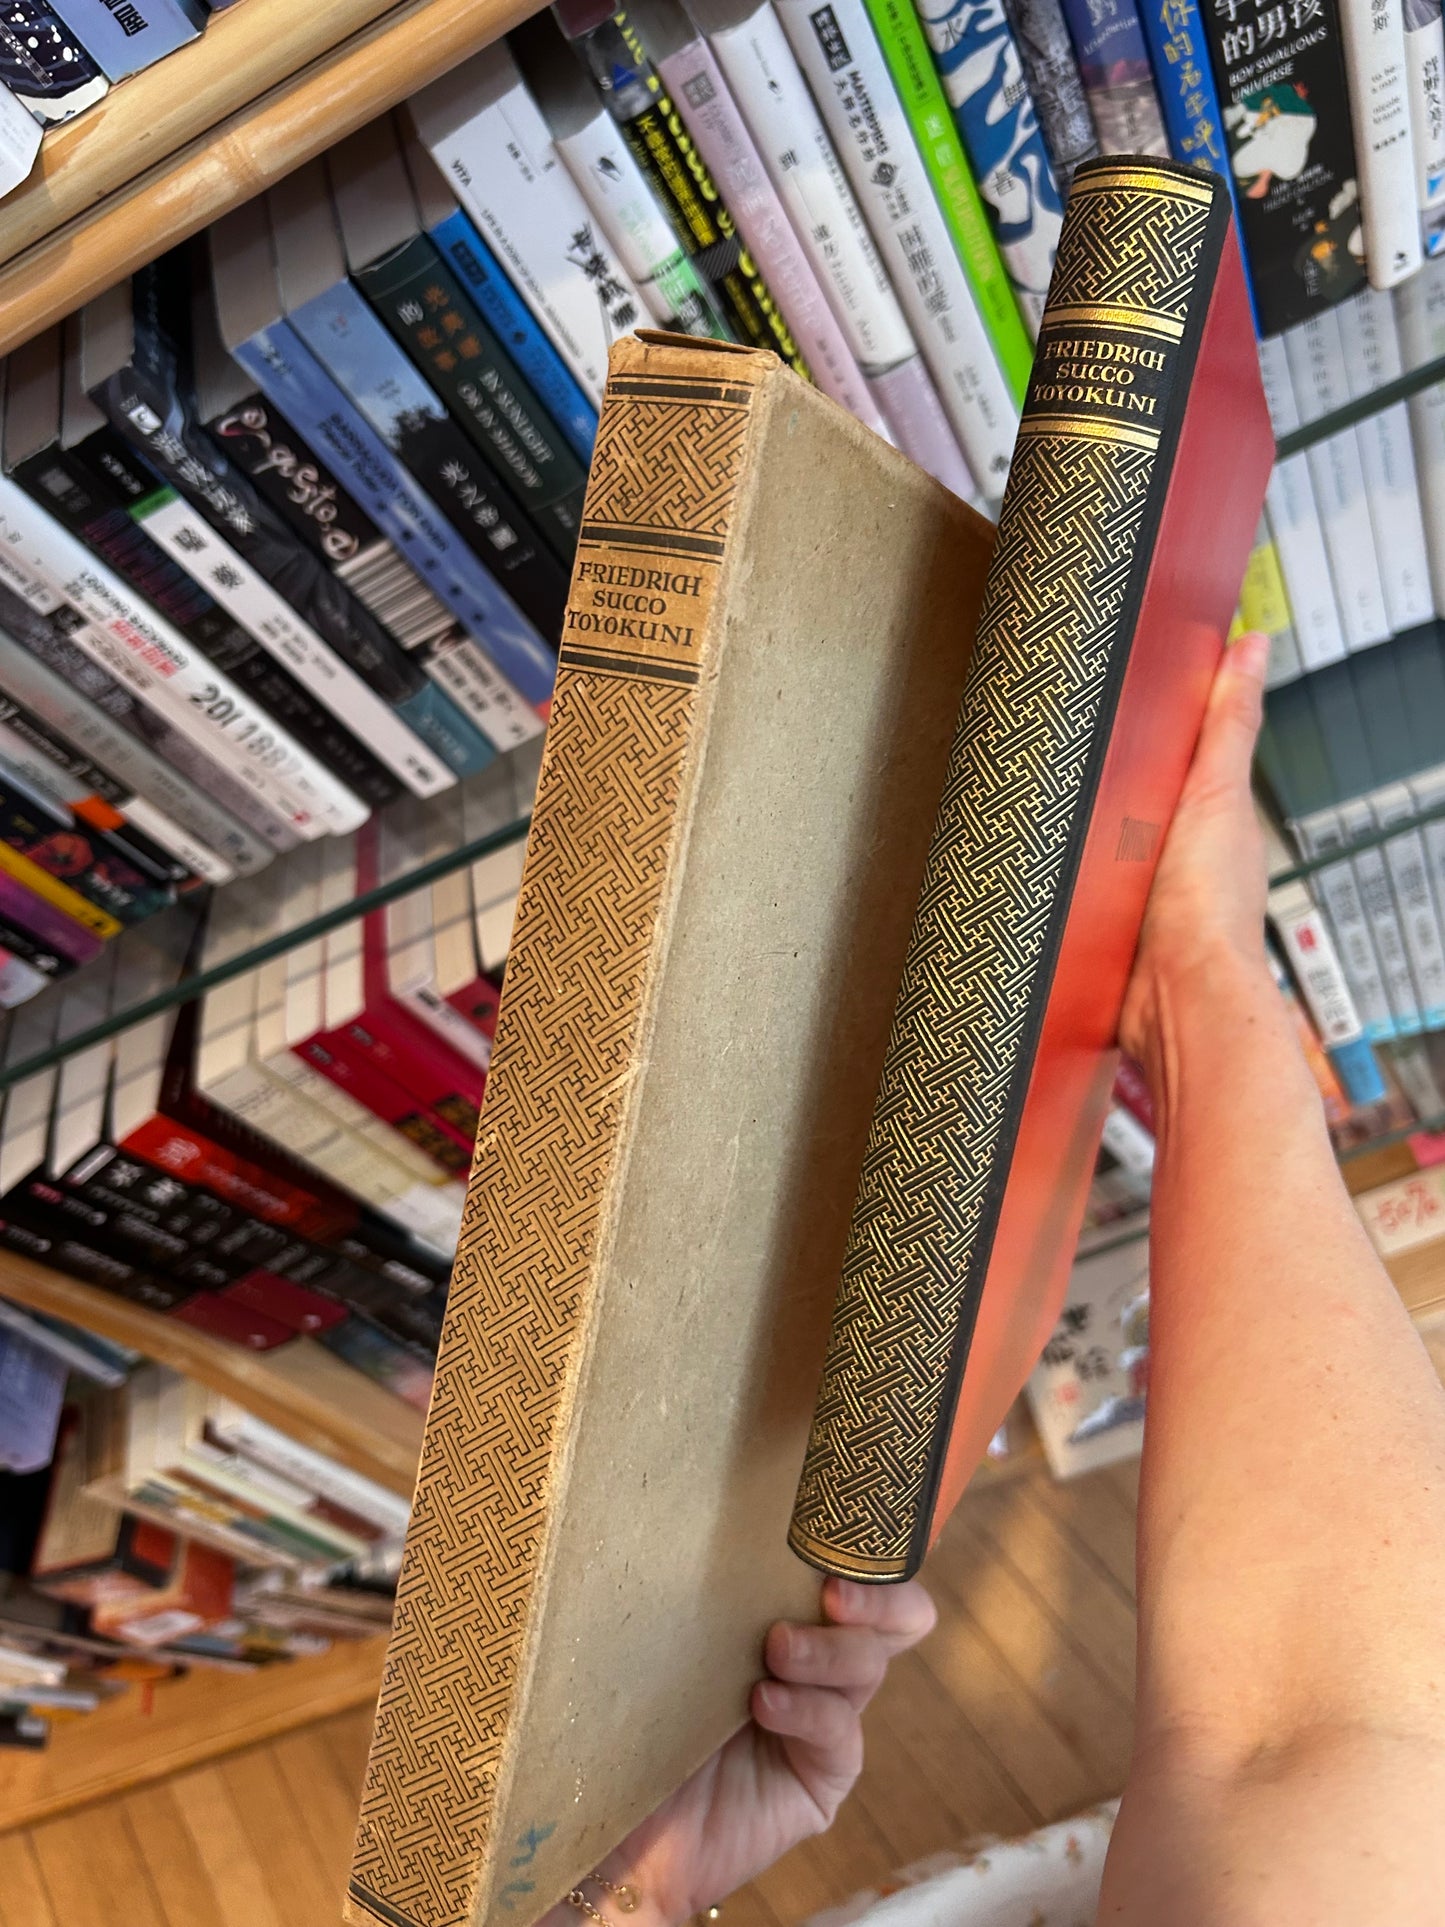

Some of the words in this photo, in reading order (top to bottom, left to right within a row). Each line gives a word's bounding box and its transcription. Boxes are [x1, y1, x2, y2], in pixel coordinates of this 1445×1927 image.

[1222, 0, 1324, 65] 的男孩
[1229, 66, 1256, 87] BOY
[1256, 25, 1328, 74] SWALLOWS
[1231, 61, 1295, 103] UNIVERSE
[450, 158, 473, 187] VITA
[1044, 340, 1167, 372] FRIEDRICH
[1056, 362, 1136, 386] SUCCO
[1034, 384, 1158, 416] TOYOKUNI
[577, 560, 703, 597] FRIEDRICH
[592, 588, 667, 616] SUCCO
[567, 608, 695, 648] TOYOKUNI
